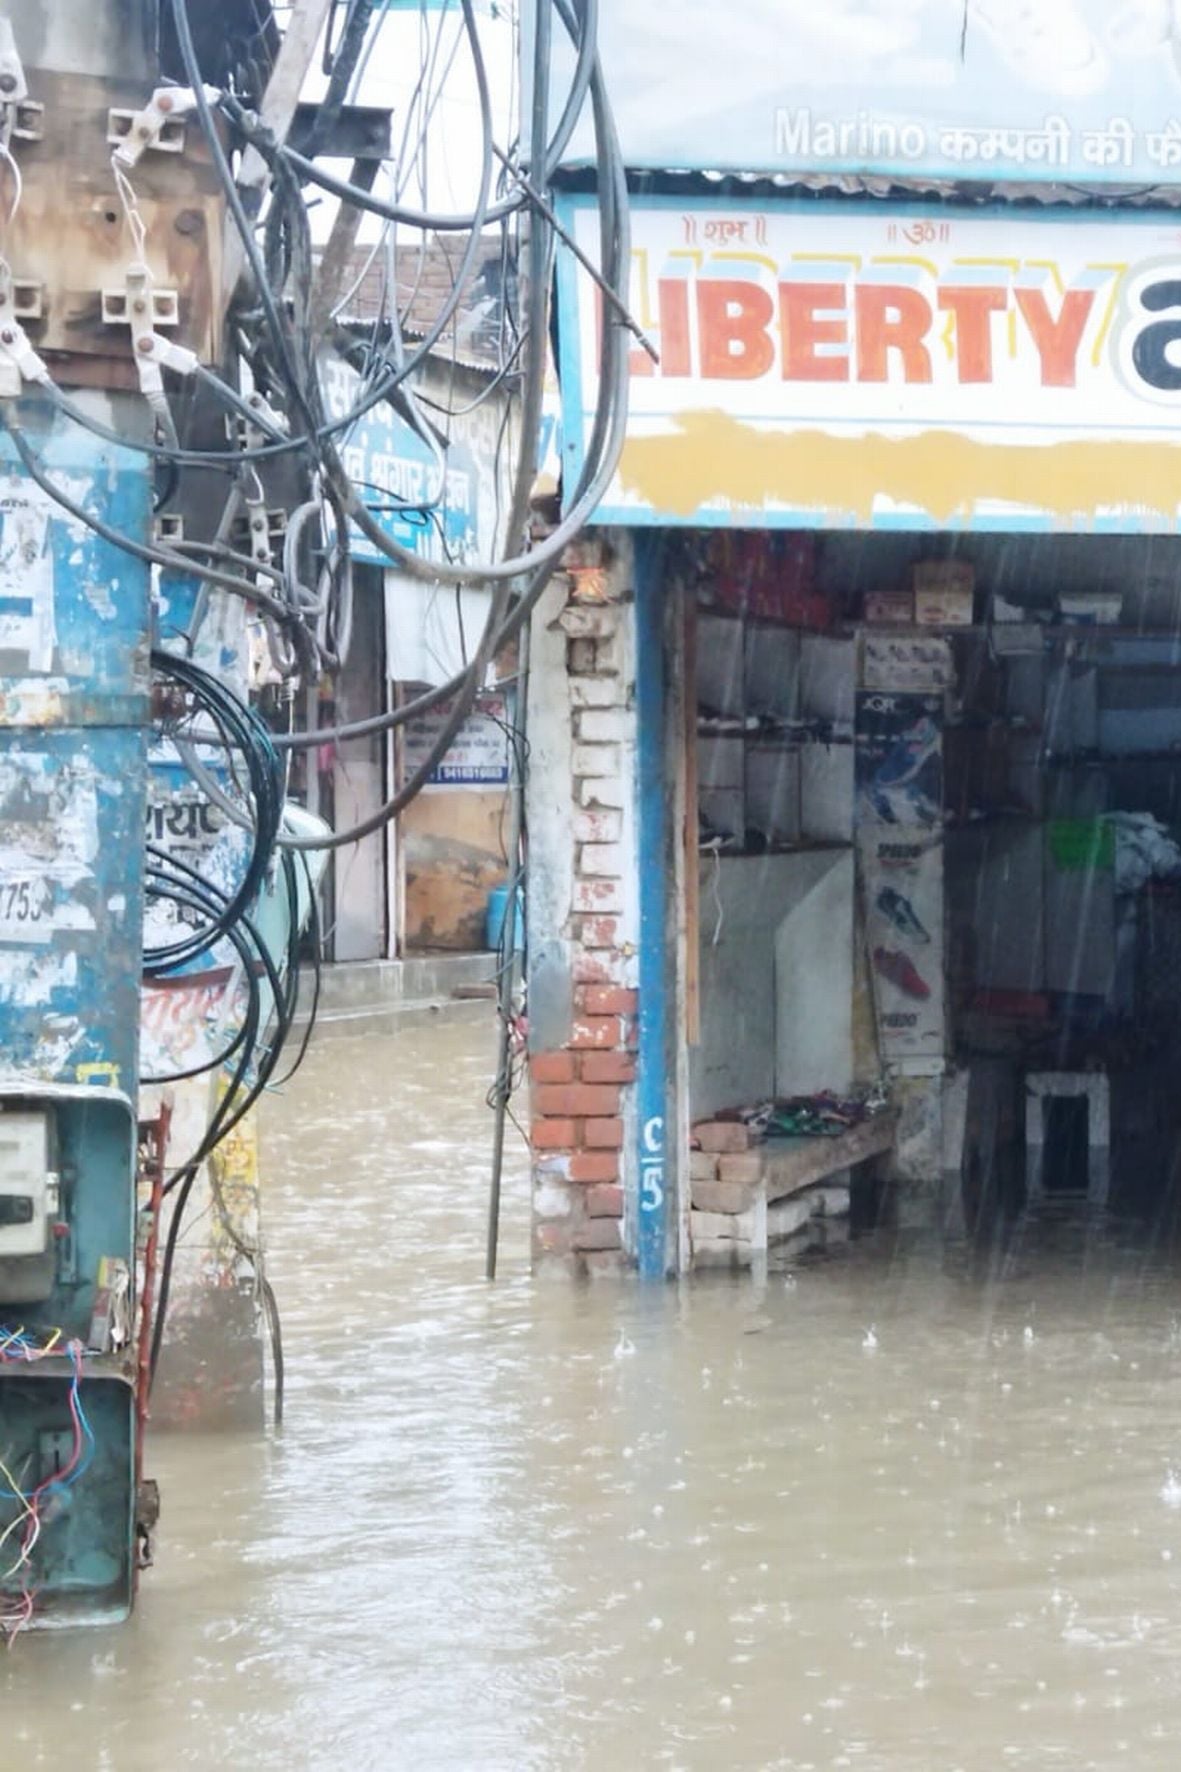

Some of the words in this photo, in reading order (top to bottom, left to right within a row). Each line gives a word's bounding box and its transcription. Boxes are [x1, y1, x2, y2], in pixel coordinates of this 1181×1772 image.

[774, 107, 925, 158] Marino
[939, 116, 1070, 164] कम्पनी
[1082, 117, 1134, 166] की
